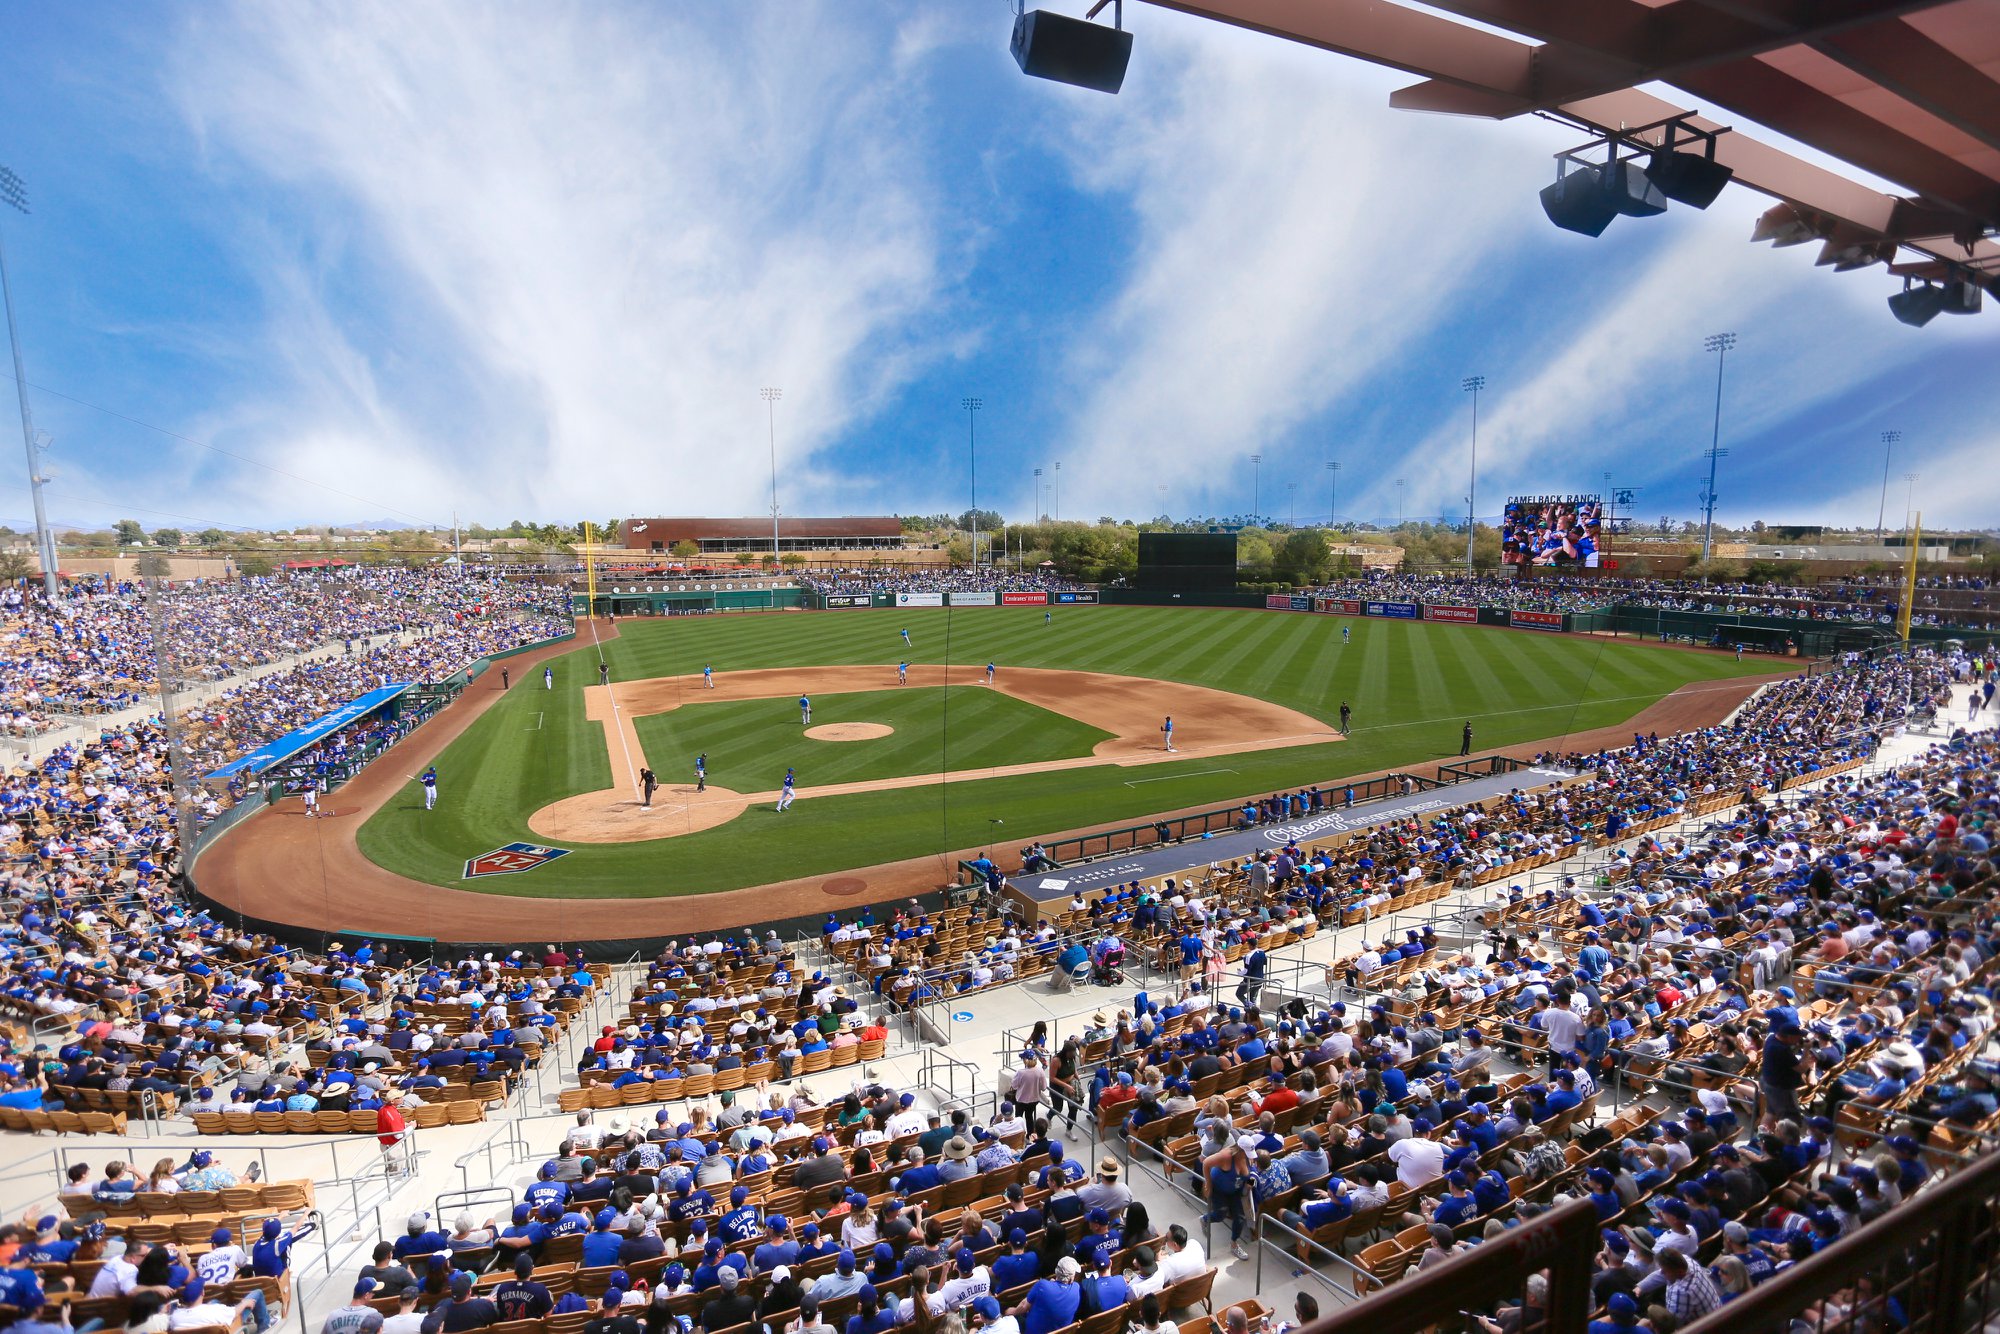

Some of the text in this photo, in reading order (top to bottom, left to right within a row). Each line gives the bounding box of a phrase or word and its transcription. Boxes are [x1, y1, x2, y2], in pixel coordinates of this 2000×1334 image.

[1507, 493, 1601, 505] CAMELBACK RANCH
[1264, 812, 1349, 844] Chicago
[481, 854, 536, 868] AZ
[1069, 863, 1140, 881] CAMELBACK
[1074, 872, 1116, 884] RANCH
[1580, 1080, 1594, 1098] 22
[144, 1094, 152, 1103] 13
[533, 1188, 558, 1198] KERSHAW
[679, 1198, 702, 1213] KERSHAW
[737, 1220, 758, 1240] 35
[201, 1254, 232, 1268] KERSHAW
[202, 1264, 229, 1284] 22
[501, 1291, 534, 1302] HERNANDEZ
[504, 1302, 526, 1320] 34
[332, 1315, 361, 1330] GRIFFE
